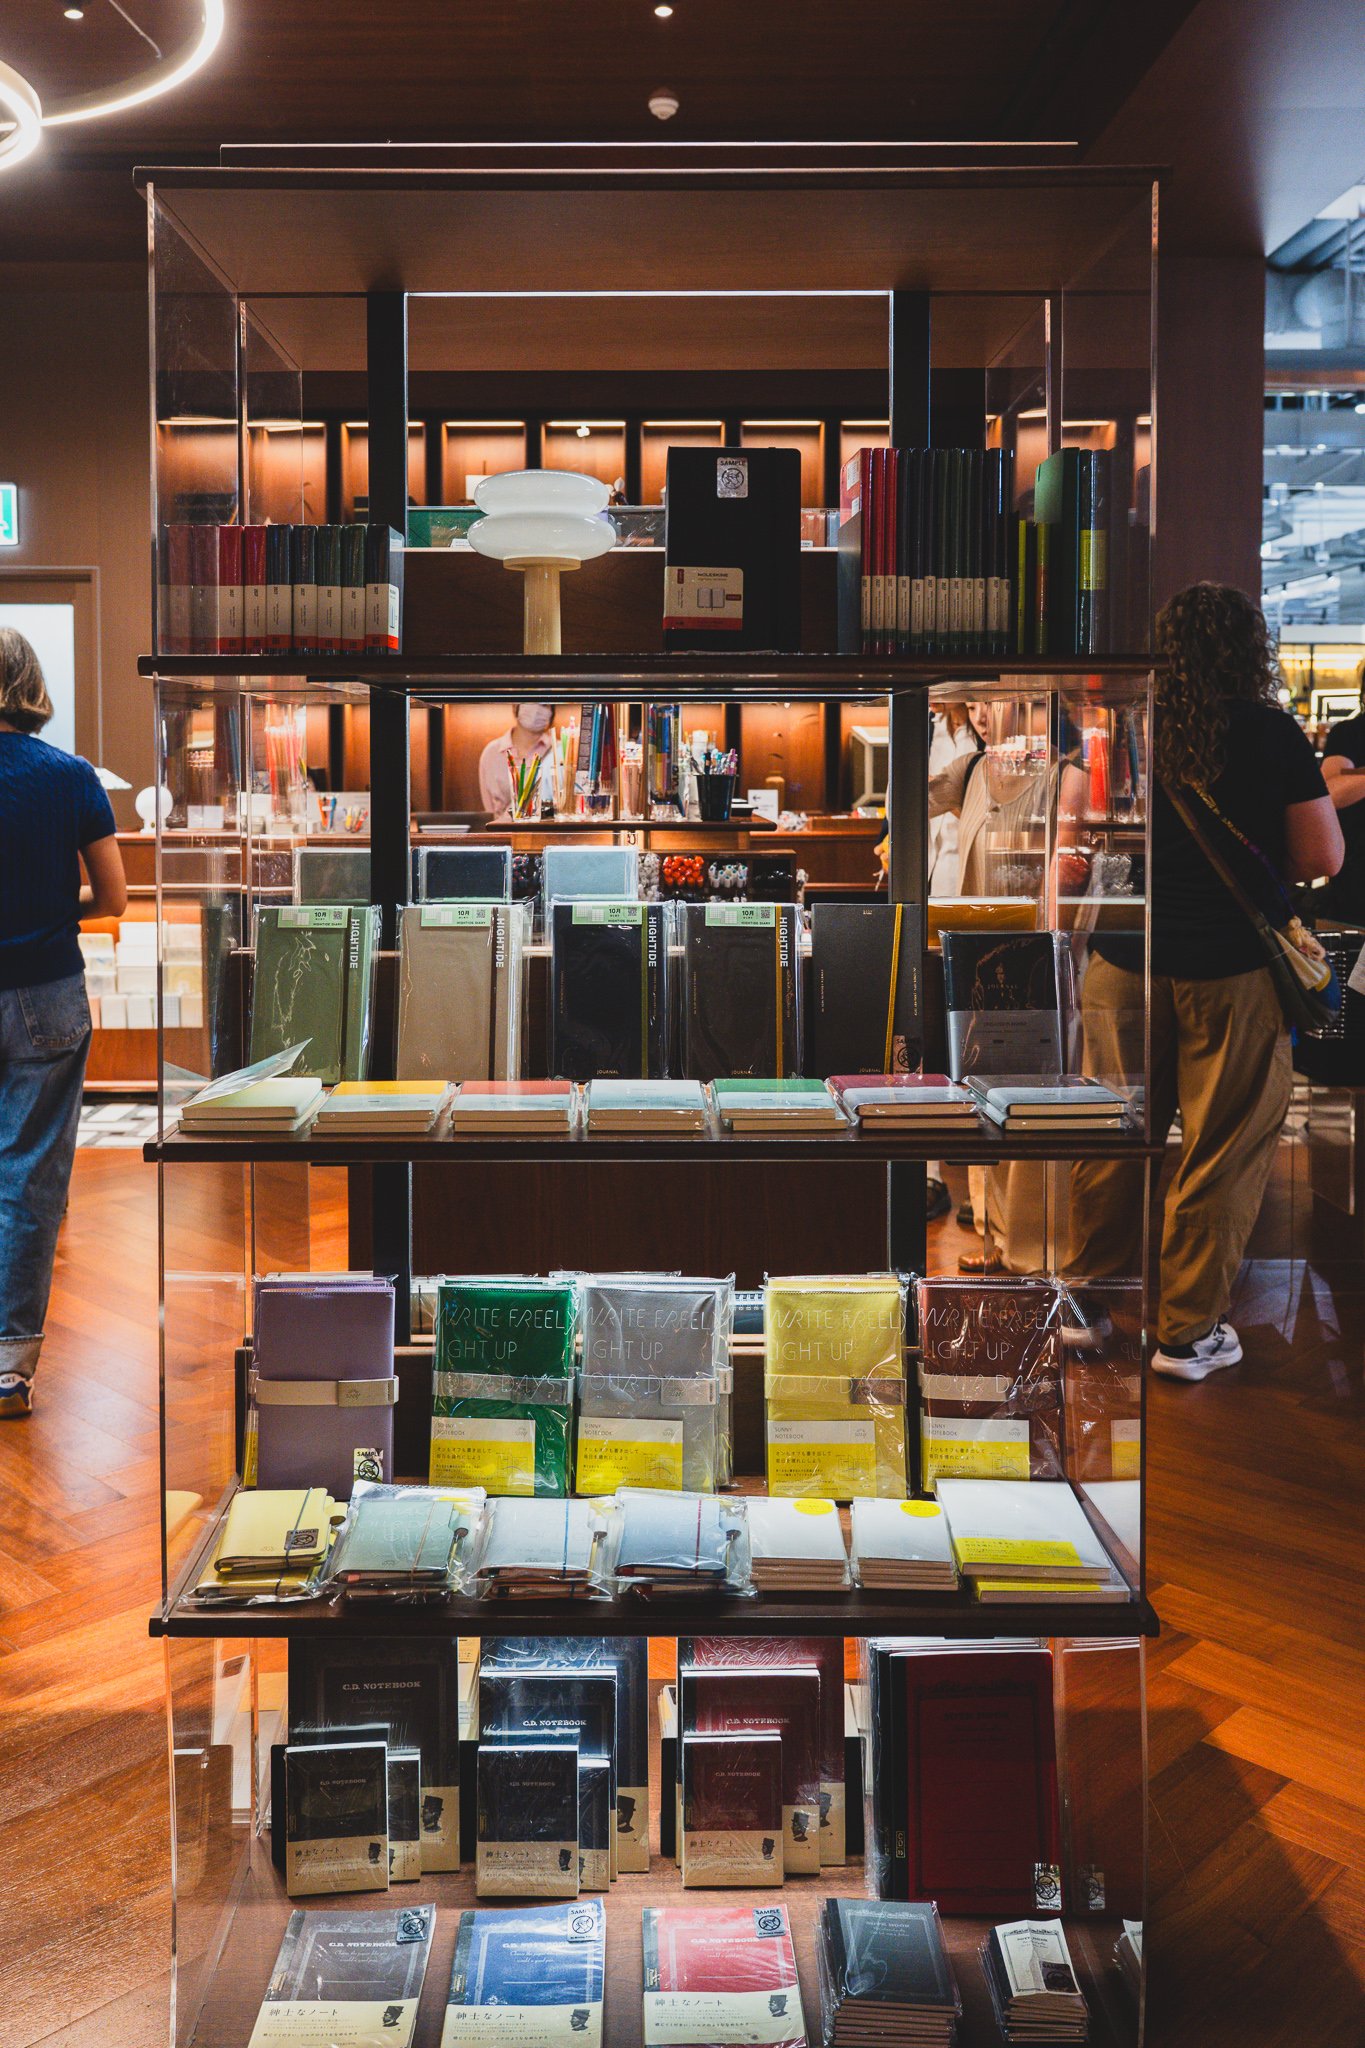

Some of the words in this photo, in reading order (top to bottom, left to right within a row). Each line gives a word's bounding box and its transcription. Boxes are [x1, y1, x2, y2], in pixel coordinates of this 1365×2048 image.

[349, 918, 360, 969] HIGHTIDE
[495, 917, 505, 968] HIGHTIDE
[648, 916, 657, 967] HIGHTIDE
[779, 916, 789, 967] HIGHTIDE
[439, 1307, 500, 1327] WRITE
[508, 1308, 580, 1336] FREELY
[585, 1306, 646, 1328] WRITE
[769, 1309, 834, 1329] WRITE
[495, 1341, 518, 1360] UP
[586, 1339, 634, 1360] IGHT
[641, 1341, 664, 1361] UP
[774, 1341, 824, 1361] IGHT
[830, 1342, 853, 1361] UP
[930, 1340, 979, 1360] IGHT
[986, 1341, 1010, 1361] UP
[362, 1680, 421, 1691] NOTEBOOK
[539, 1719, 588, 1727] NOTEBOOK
[742, 1717, 791, 1725] NOTEBOOK
[269, 2008, 339, 2017] 紳士なノート
[654, 1998, 723, 2007] 紳士なノート
[455, 2011, 526, 2020] 紳士なノート
